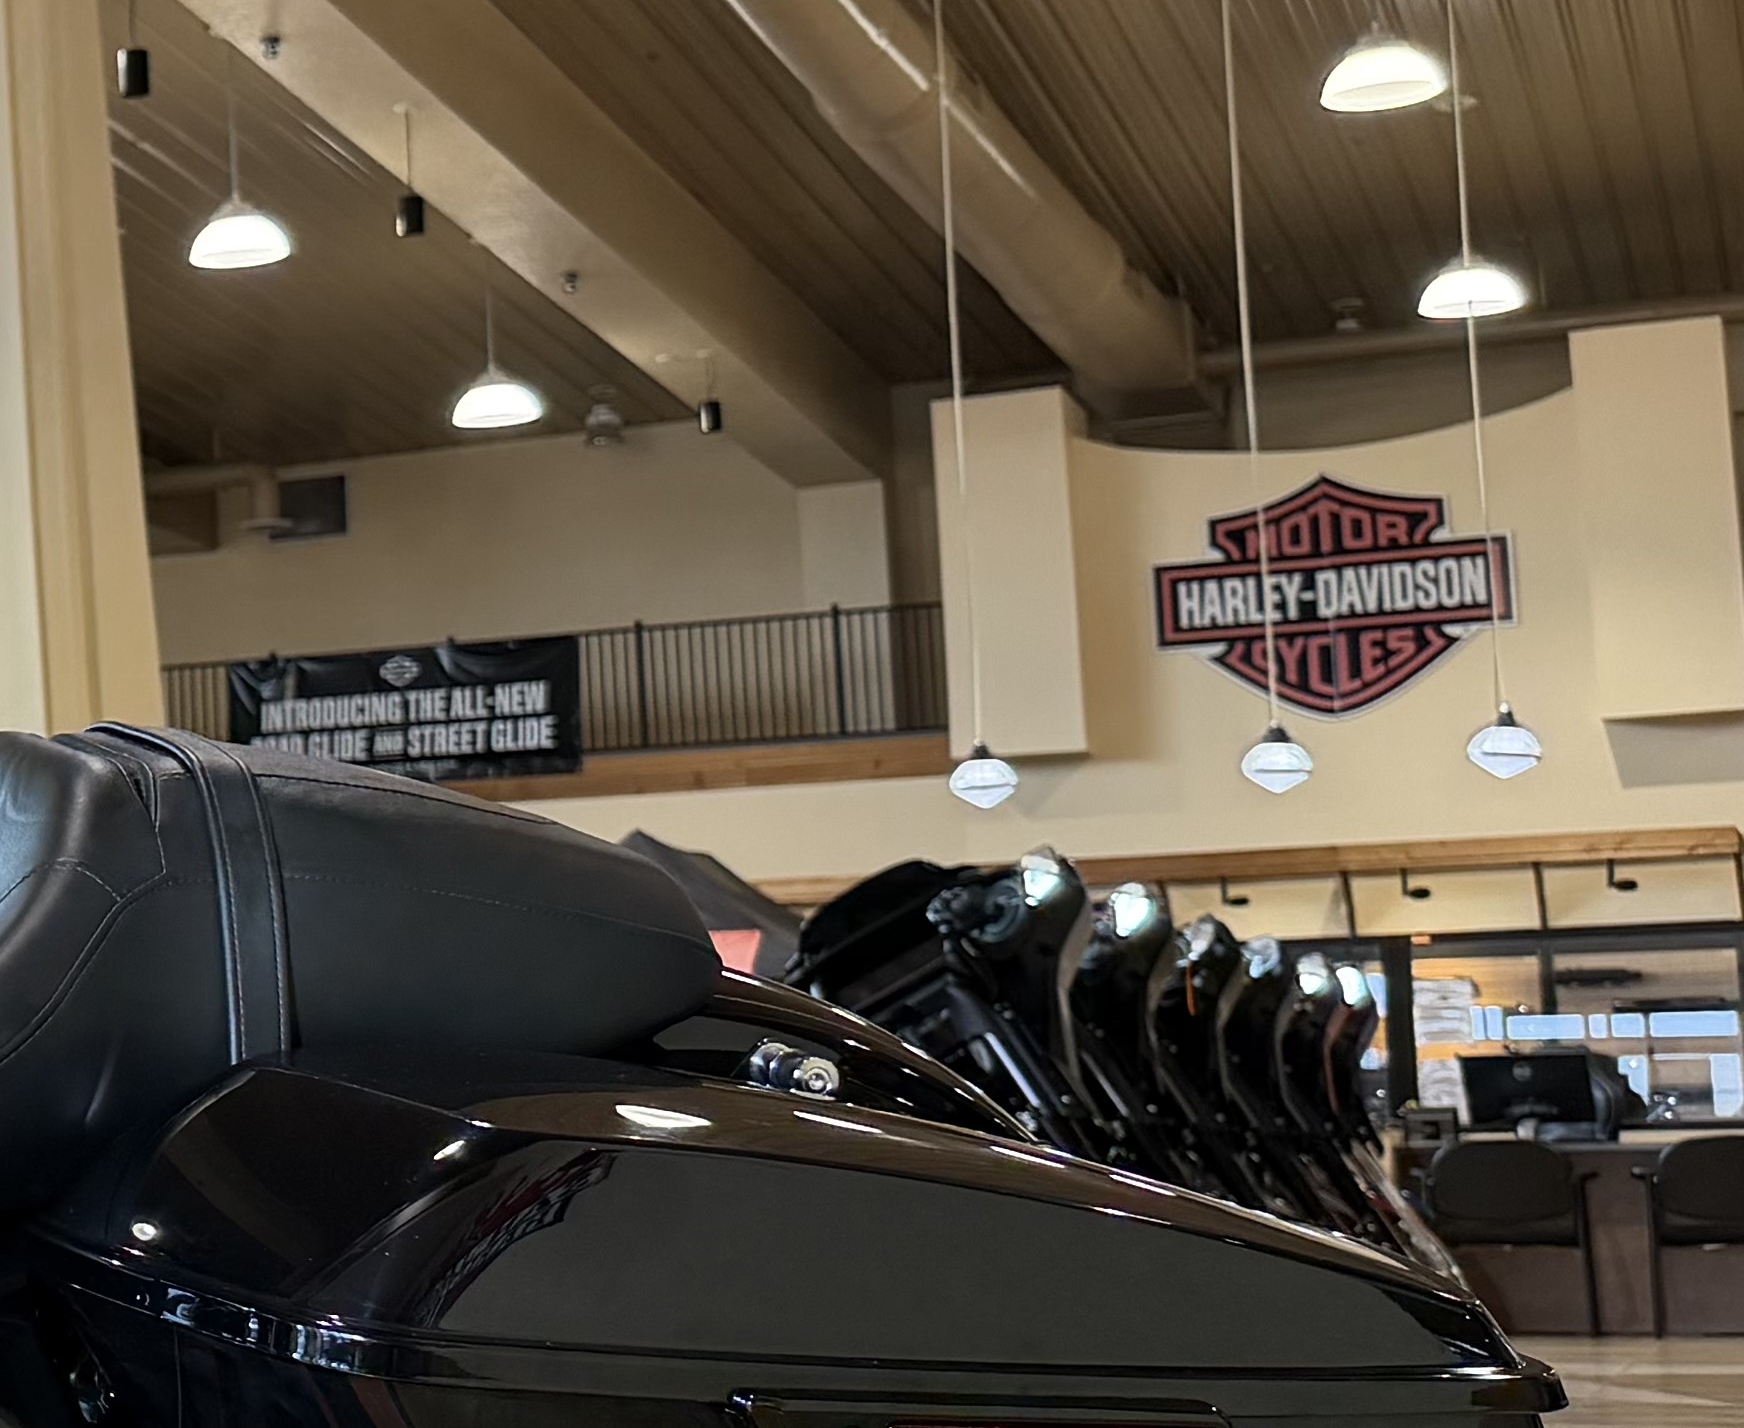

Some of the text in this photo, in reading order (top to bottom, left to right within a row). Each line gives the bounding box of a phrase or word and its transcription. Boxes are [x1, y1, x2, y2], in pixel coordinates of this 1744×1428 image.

[1246, 500, 1410, 560] MOTOR
[1177, 557, 1488, 630] HARLEY-DAVIDSON
[1252, 631, 1415, 695] CYCLES
[261, 680, 546, 733] INTRODUCING THE ALL-NEW
[373, 735, 405, 756] AND
[407, 722, 488, 758] STREET
[490, 716, 556, 751] GLIDE
